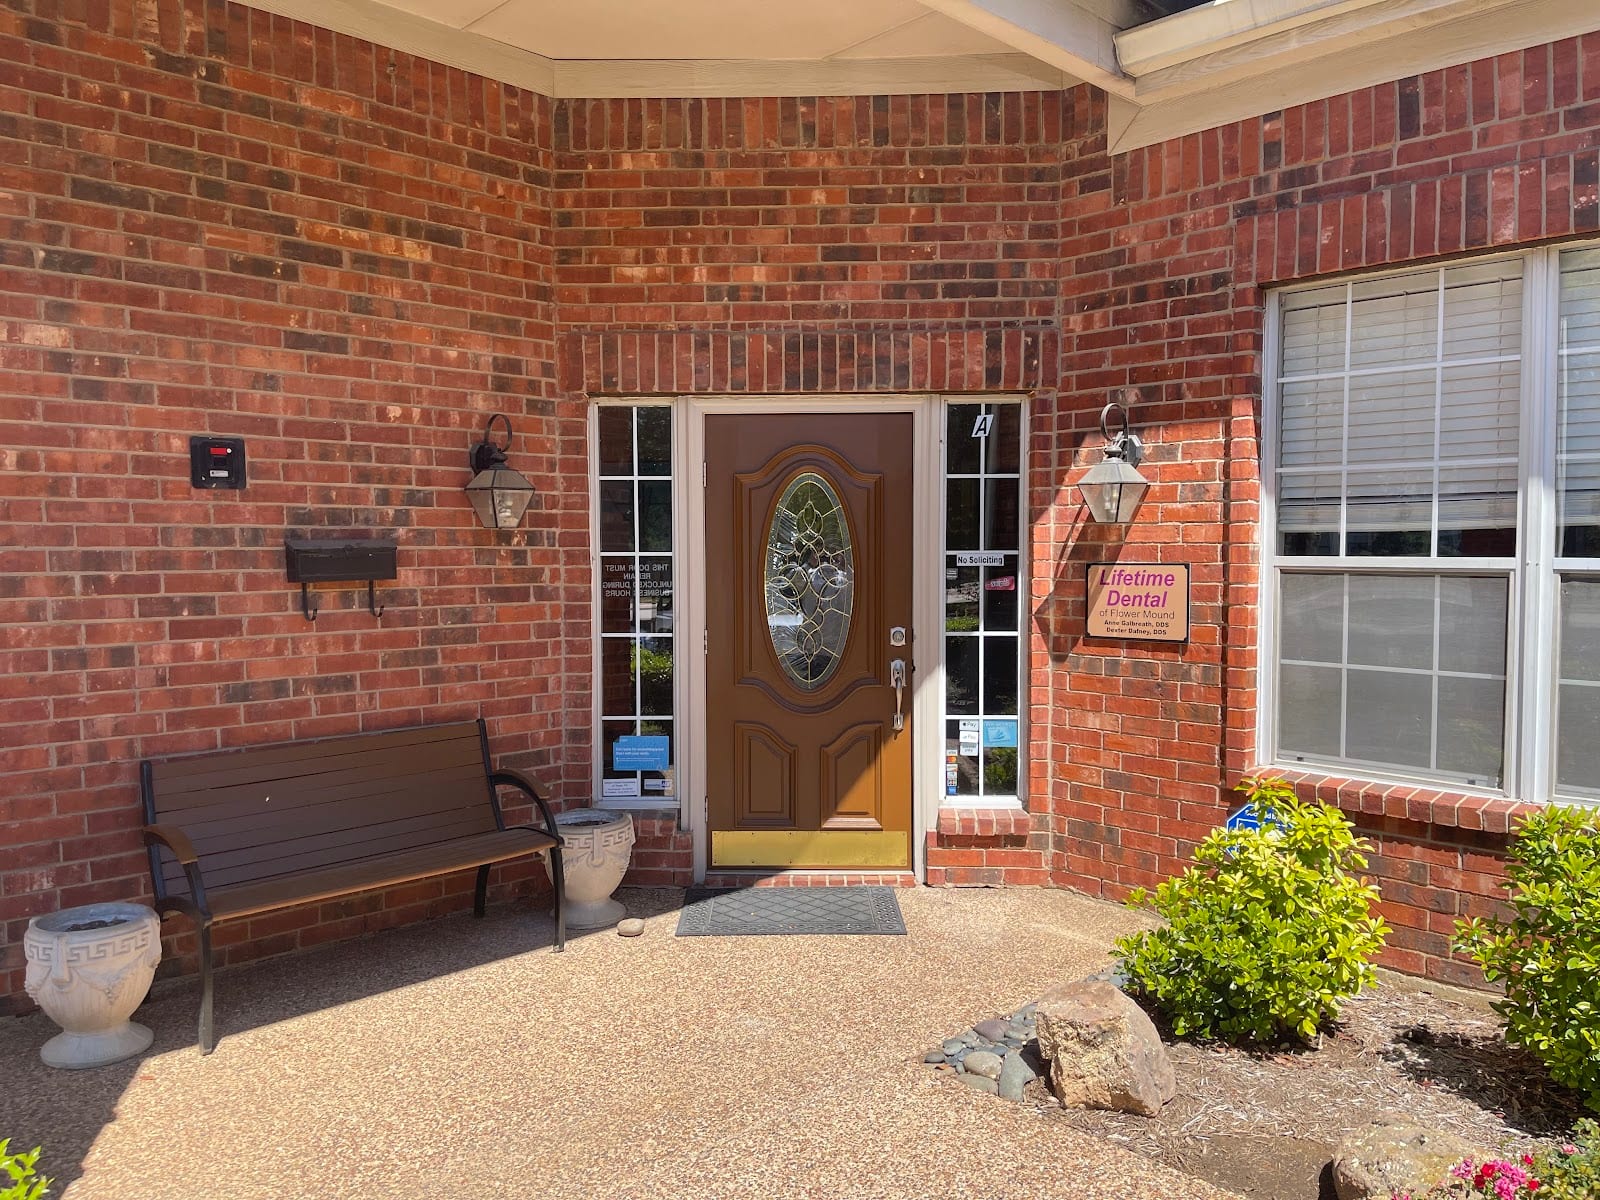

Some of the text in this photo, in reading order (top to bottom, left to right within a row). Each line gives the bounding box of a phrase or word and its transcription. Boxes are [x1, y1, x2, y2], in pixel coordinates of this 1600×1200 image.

[974, 416, 987, 436] A
[957, 555, 1003, 565] No Soliciting
[1099, 569, 1175, 587] Lifetime
[1106, 590, 1168, 608] Dental
[1099, 609, 1175, 619] of Flower Mound
